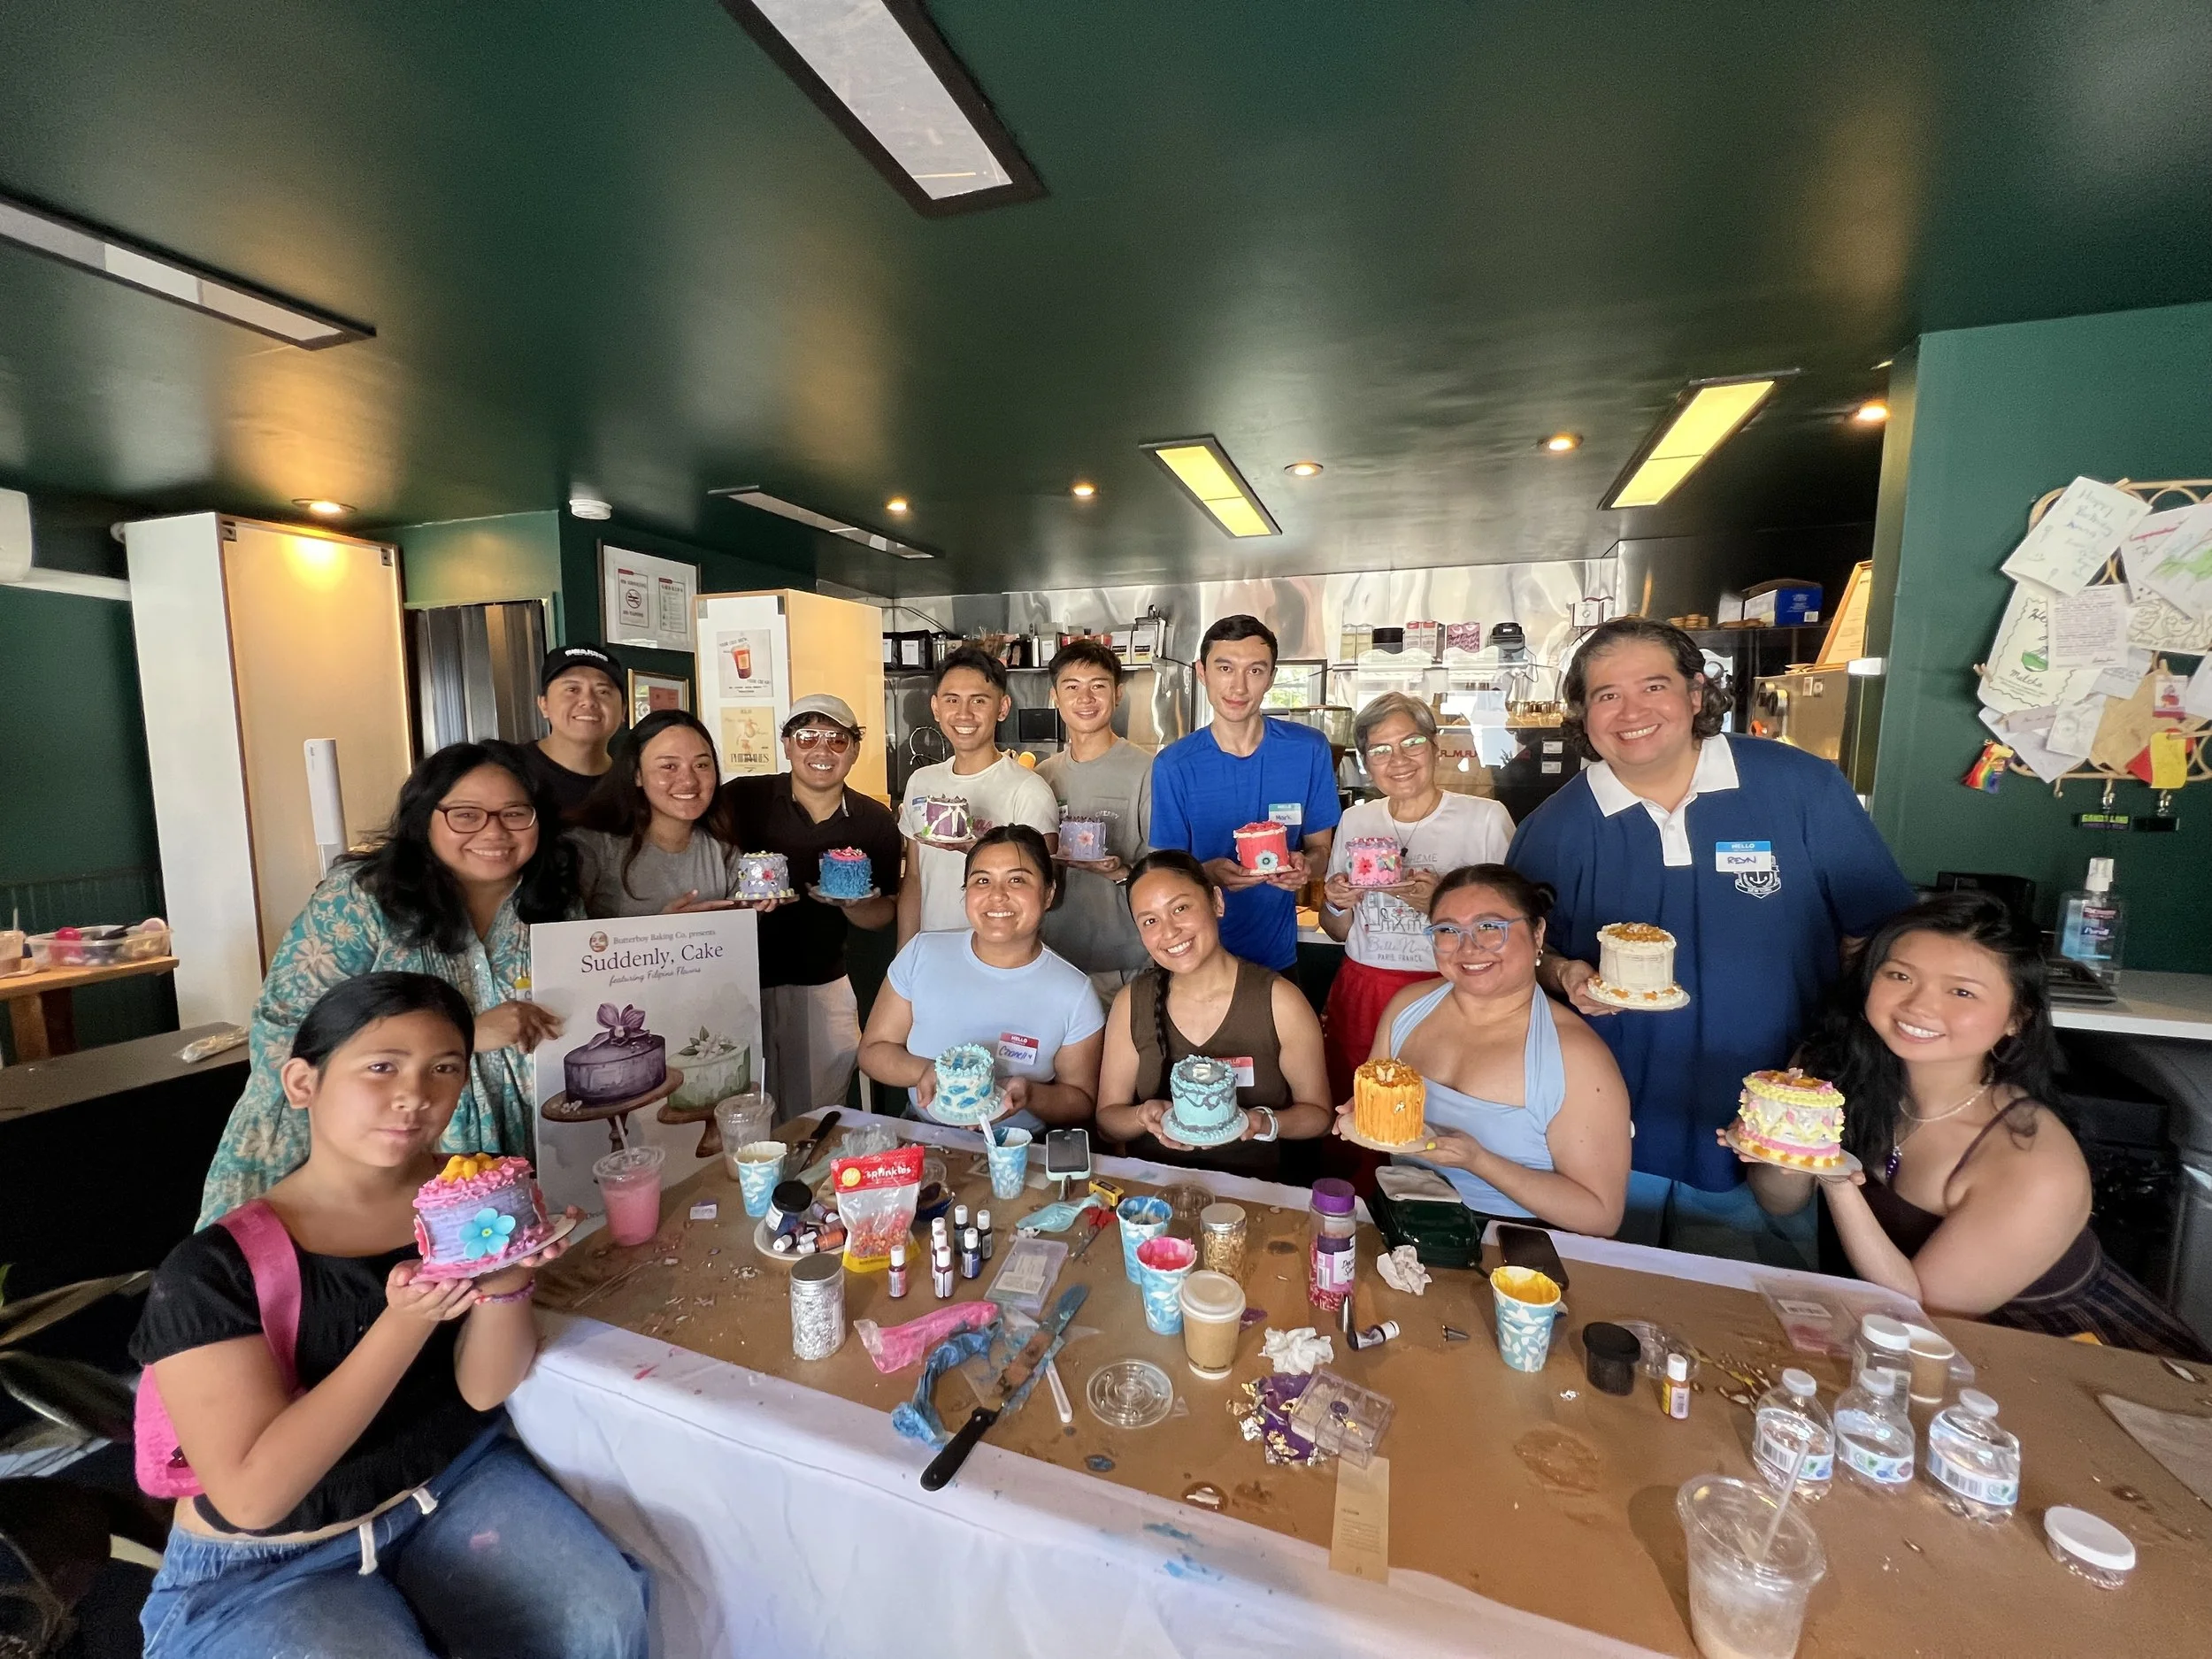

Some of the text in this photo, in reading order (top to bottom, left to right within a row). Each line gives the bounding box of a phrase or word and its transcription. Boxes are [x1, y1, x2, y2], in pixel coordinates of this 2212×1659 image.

[613, 929, 716, 945] Butterboy Baking Co. presents
[580, 942, 724, 973] Suddenly, Cake
[609, 973, 645, 987] featuring
[865, 1164, 912, 1180] sprinkles
